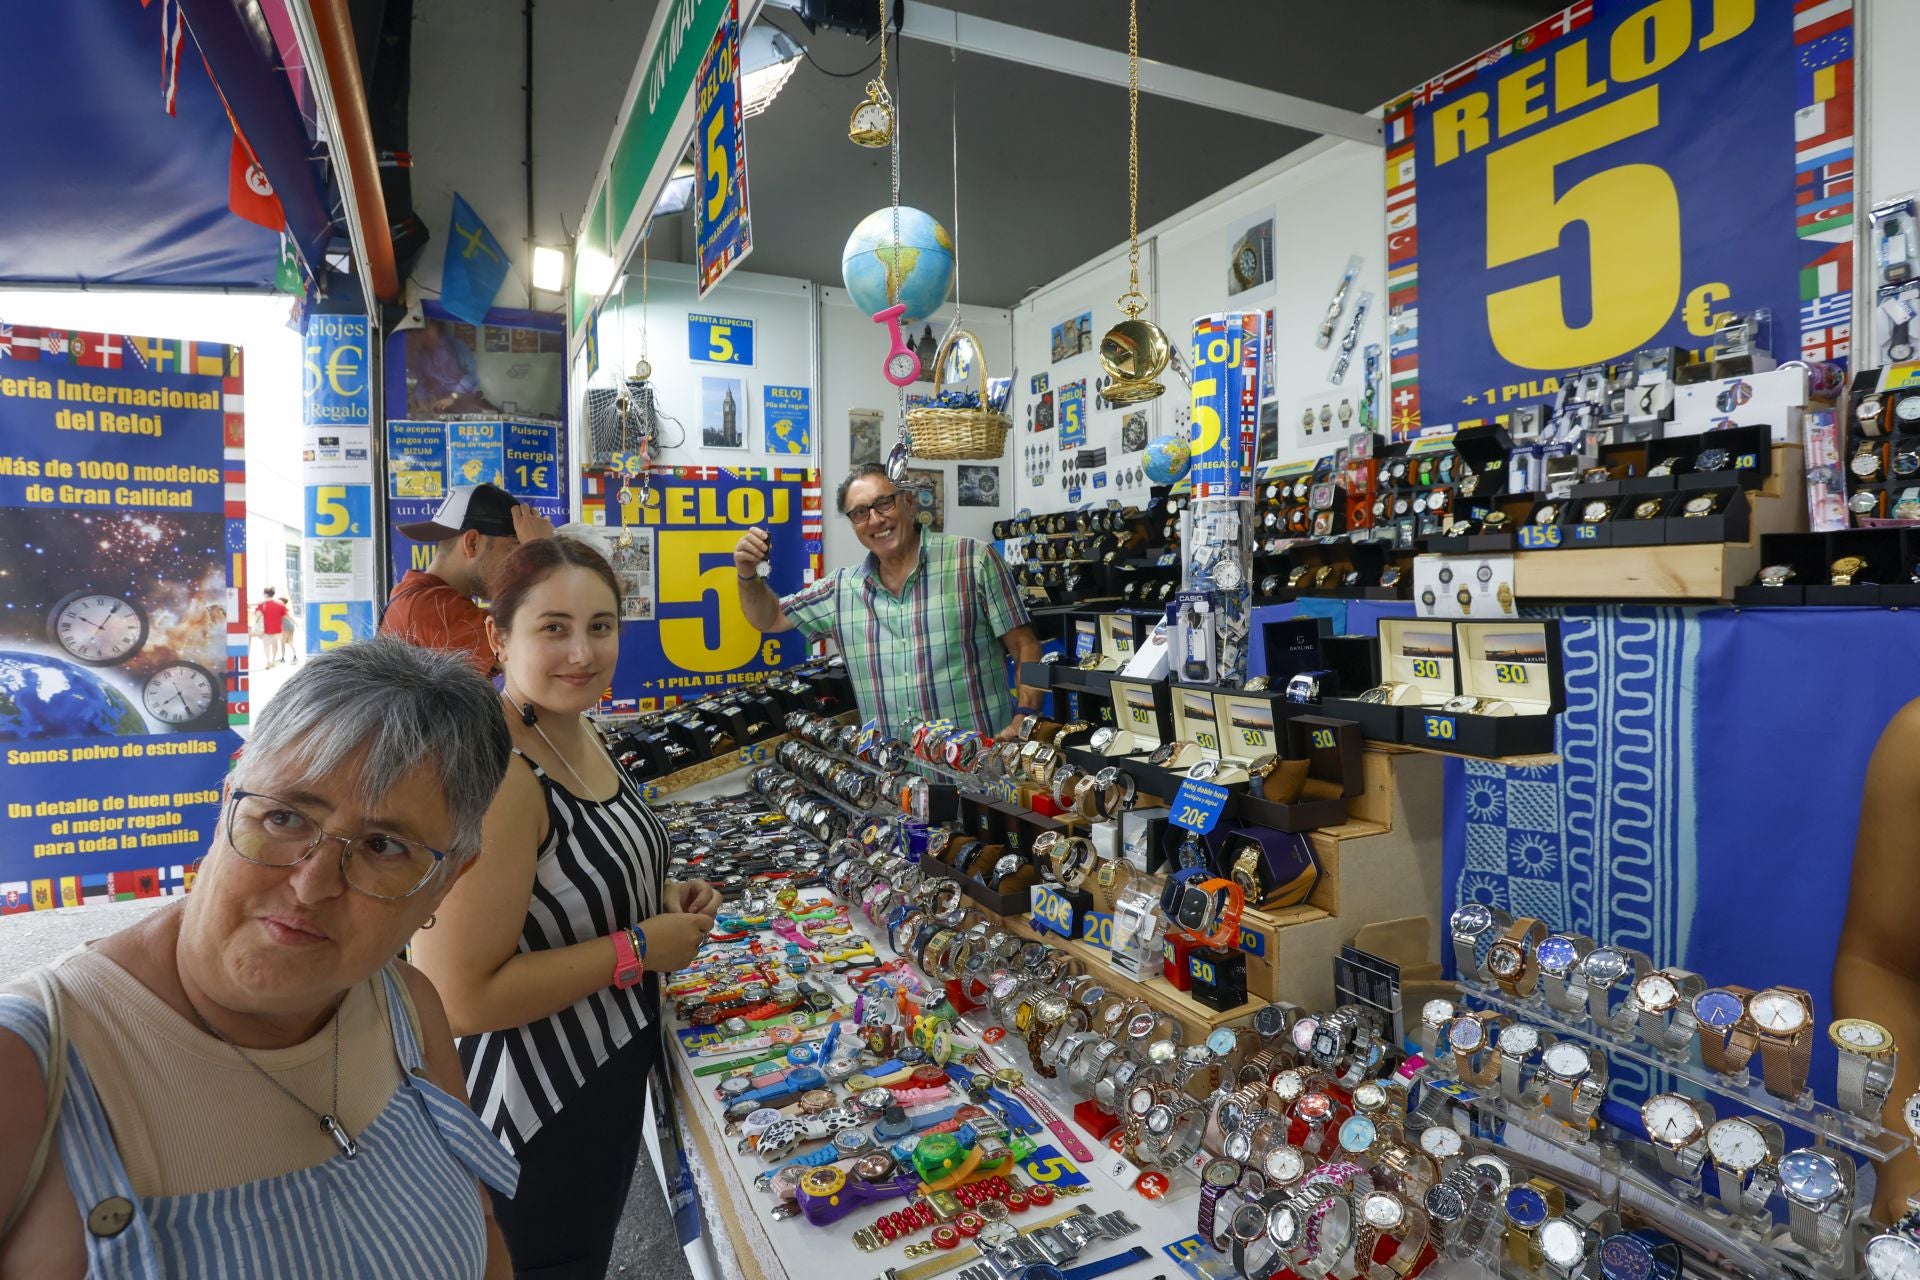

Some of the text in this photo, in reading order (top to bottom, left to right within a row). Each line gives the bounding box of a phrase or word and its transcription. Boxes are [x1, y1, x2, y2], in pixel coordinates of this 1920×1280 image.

[649, 0, 702, 115] UN MA
[700, 38, 733, 121] RELOJ
[1433, 0, 1756, 168] RELOJ
[1880, 284, 1912, 296] CASIO
[310, 318, 366, 341] elojes
[689, 314, 752, 328] OFERTA ESPECIAL
[0, 376, 220, 411] eria Internacional
[771, 388, 803, 401] RELOJ
[1061, 389, 1083, 402] RELOJ
[1482, 388, 1496, 405] 1
[1502, 377, 1560, 402] PILA
[55, 408, 164, 437] del Reloj
[311, 402, 368, 420] Regalo
[394, 425, 442, 435] Se aceptan
[396, 436, 422, 445] pagos
[458, 426, 494, 438] RELOJ
[511, 426, 549, 437] Pulsera
[403, 447, 433, 456] BIZUM
[45, 458, 73, 478] de
[76, 460, 130, 482] 1000
[133, 462, 220, 485] modelos
[515, 465, 549, 489] 1€
[1484, 460, 1502, 471] 30
[25, 483, 194, 508] de Gran Calidad
[621, 486, 790, 525] RELOJ
[396, 504, 417, 516] un
[1519, 525, 1561, 545] 15€
[1577, 526, 1596, 538] 15
[656, 679, 665, 689] 1
[668, 677, 702, 688] PILA
[703, 674, 724, 686] DE
[7, 739, 218, 766] Somos polvo de estrellas
[739, 746, 765, 763] 5€
[8, 788, 220, 819] Un detalle de buen gusto
[1213, 788, 1229, 803] hora
[51, 811, 183, 836] el mejor regalo
[1178, 806, 1210, 829] 20€
[33, 828, 200, 860] para toda la familia
[1033, 887, 1073, 931] 20€
[1191, 959, 1213, 982] 30
[1027, 1156, 1078, 1183] 5
[1141, 1174, 1161, 1193] 5€
